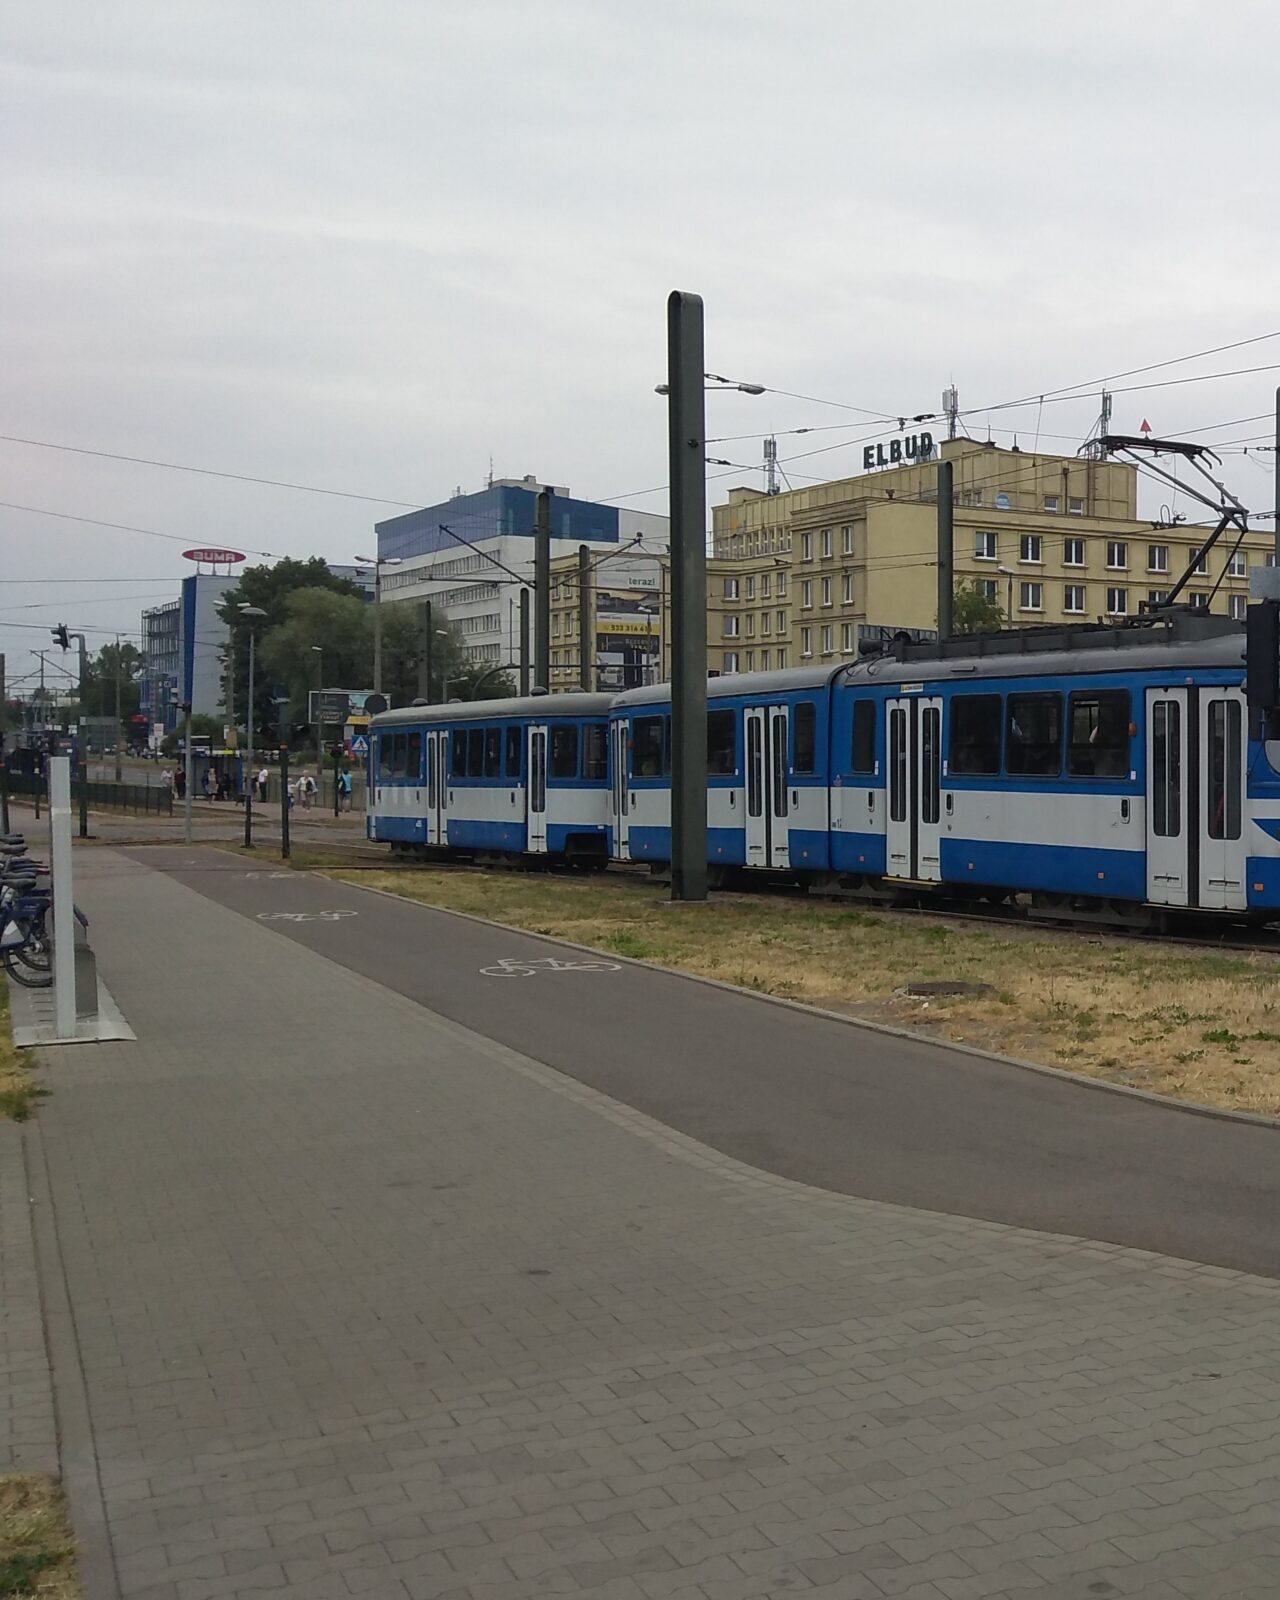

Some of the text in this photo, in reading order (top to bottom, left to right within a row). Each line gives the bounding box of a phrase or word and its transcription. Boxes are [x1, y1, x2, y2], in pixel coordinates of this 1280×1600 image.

[863, 432, 933, 469] ELBUD
[193, 551, 235, 561] BUMA
[628, 577, 655, 586] teraz!
